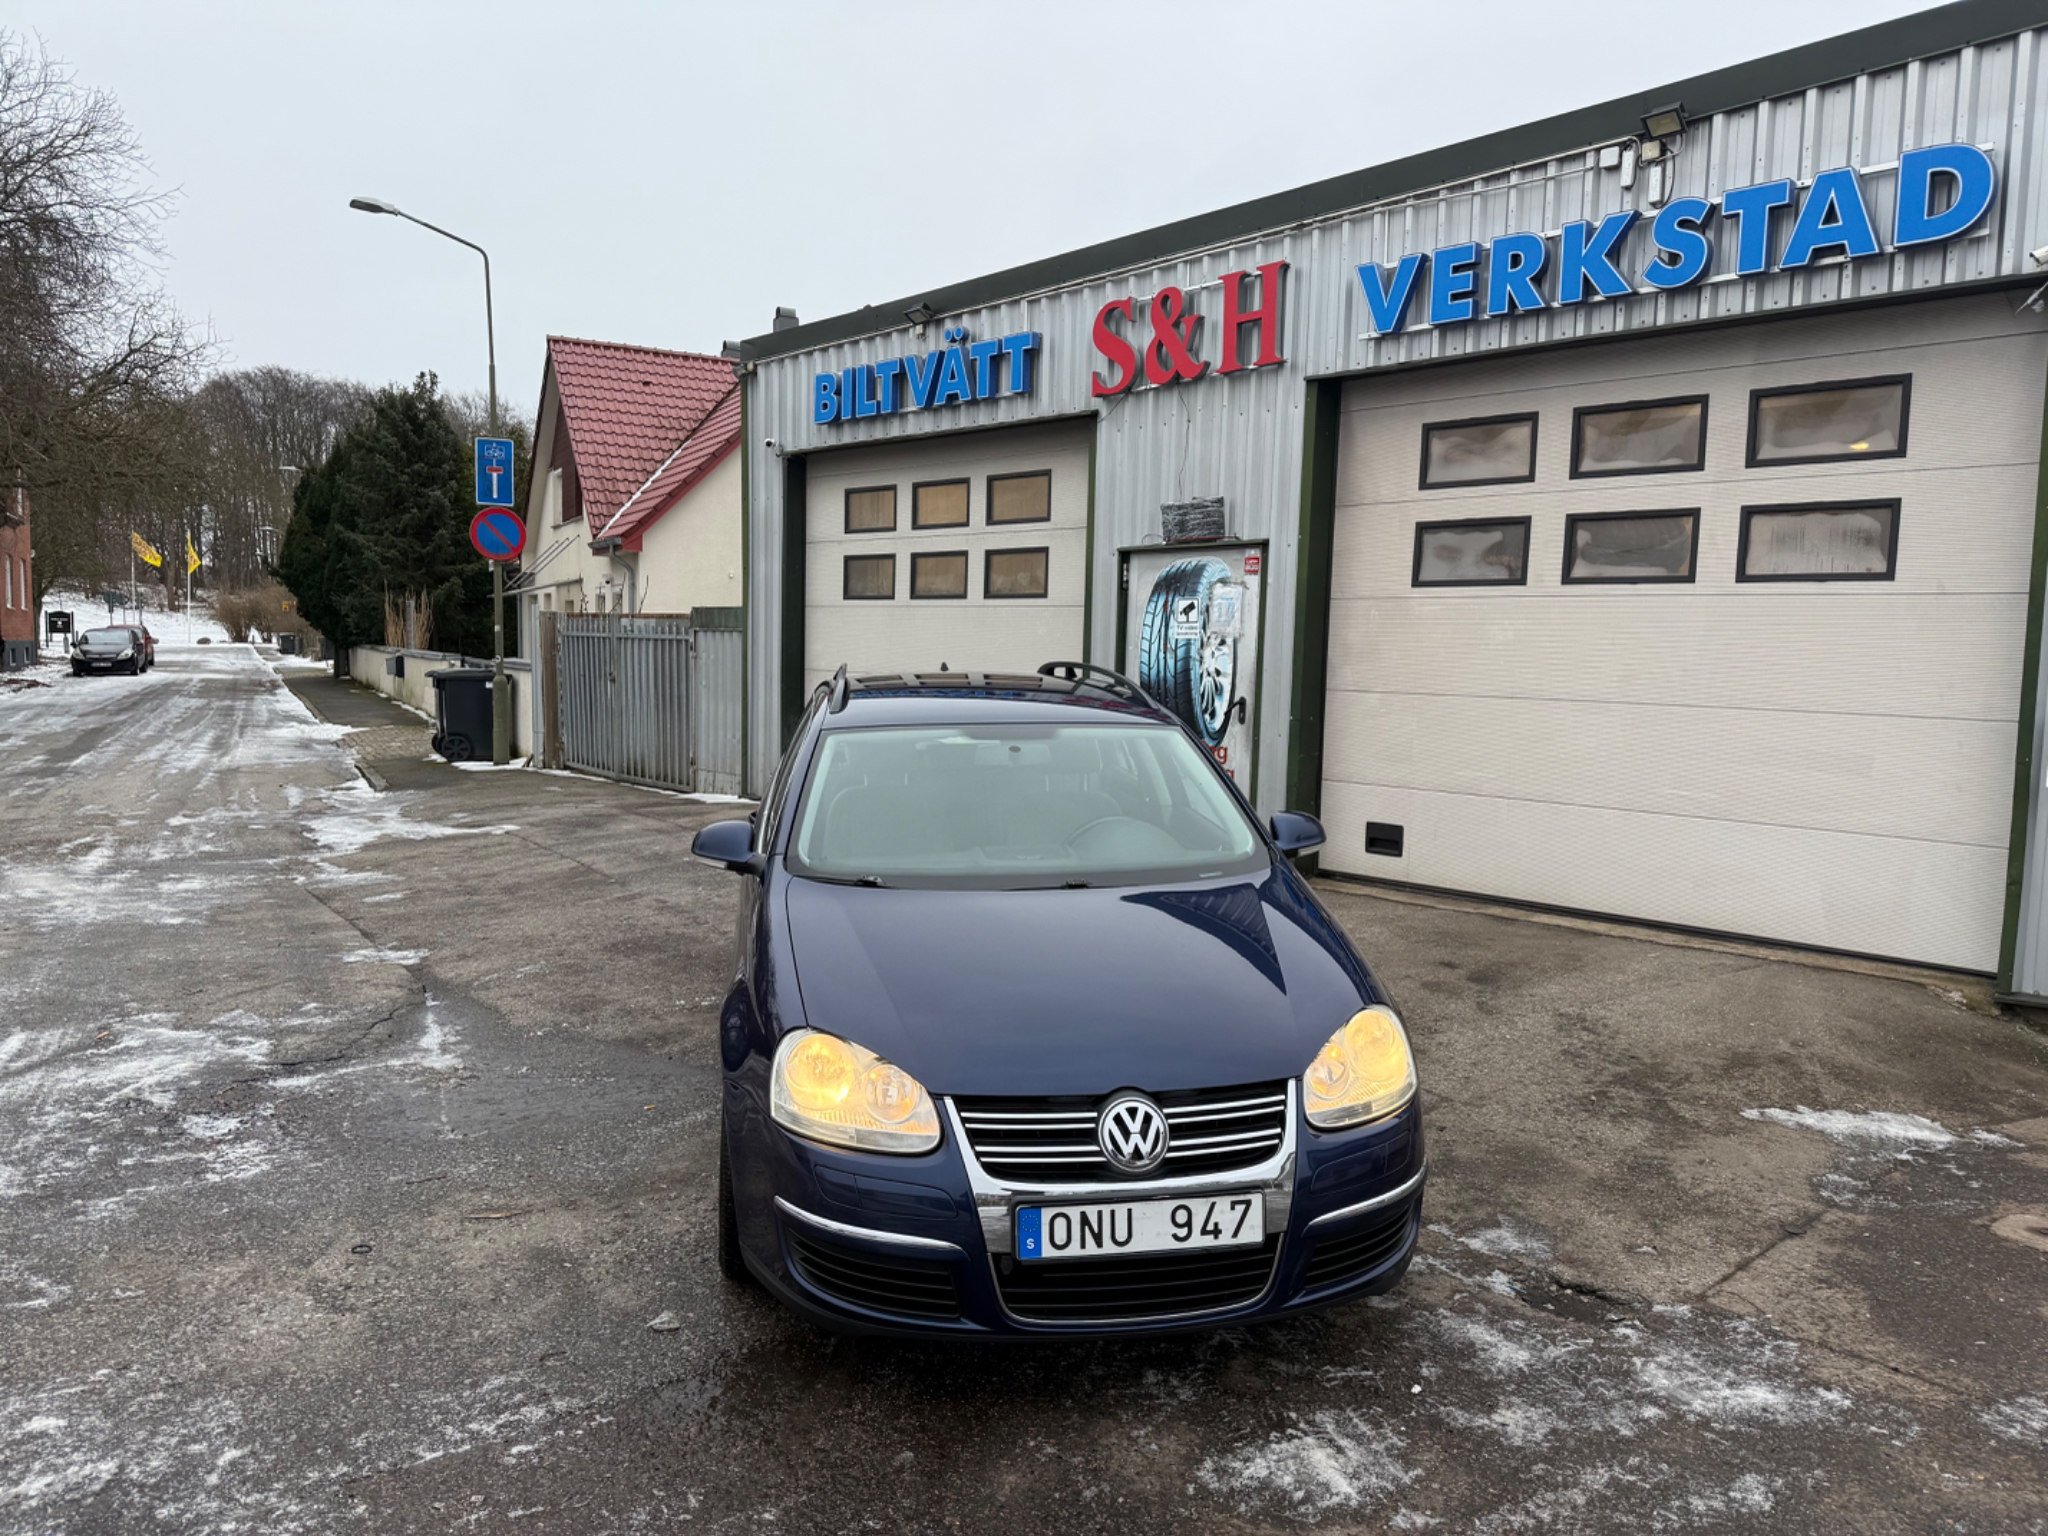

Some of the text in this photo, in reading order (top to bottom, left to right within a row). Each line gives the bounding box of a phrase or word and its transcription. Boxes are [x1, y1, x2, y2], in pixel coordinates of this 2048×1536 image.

[1355, 142, 1998, 335] VERKSTAD
[814, 326, 1041, 425] BILTVÄTT
[1091, 260, 1289, 398] S&H
[1098, 1096, 1169, 1171] VW
[1025, 1198, 1252, 1251] S ONU 947
